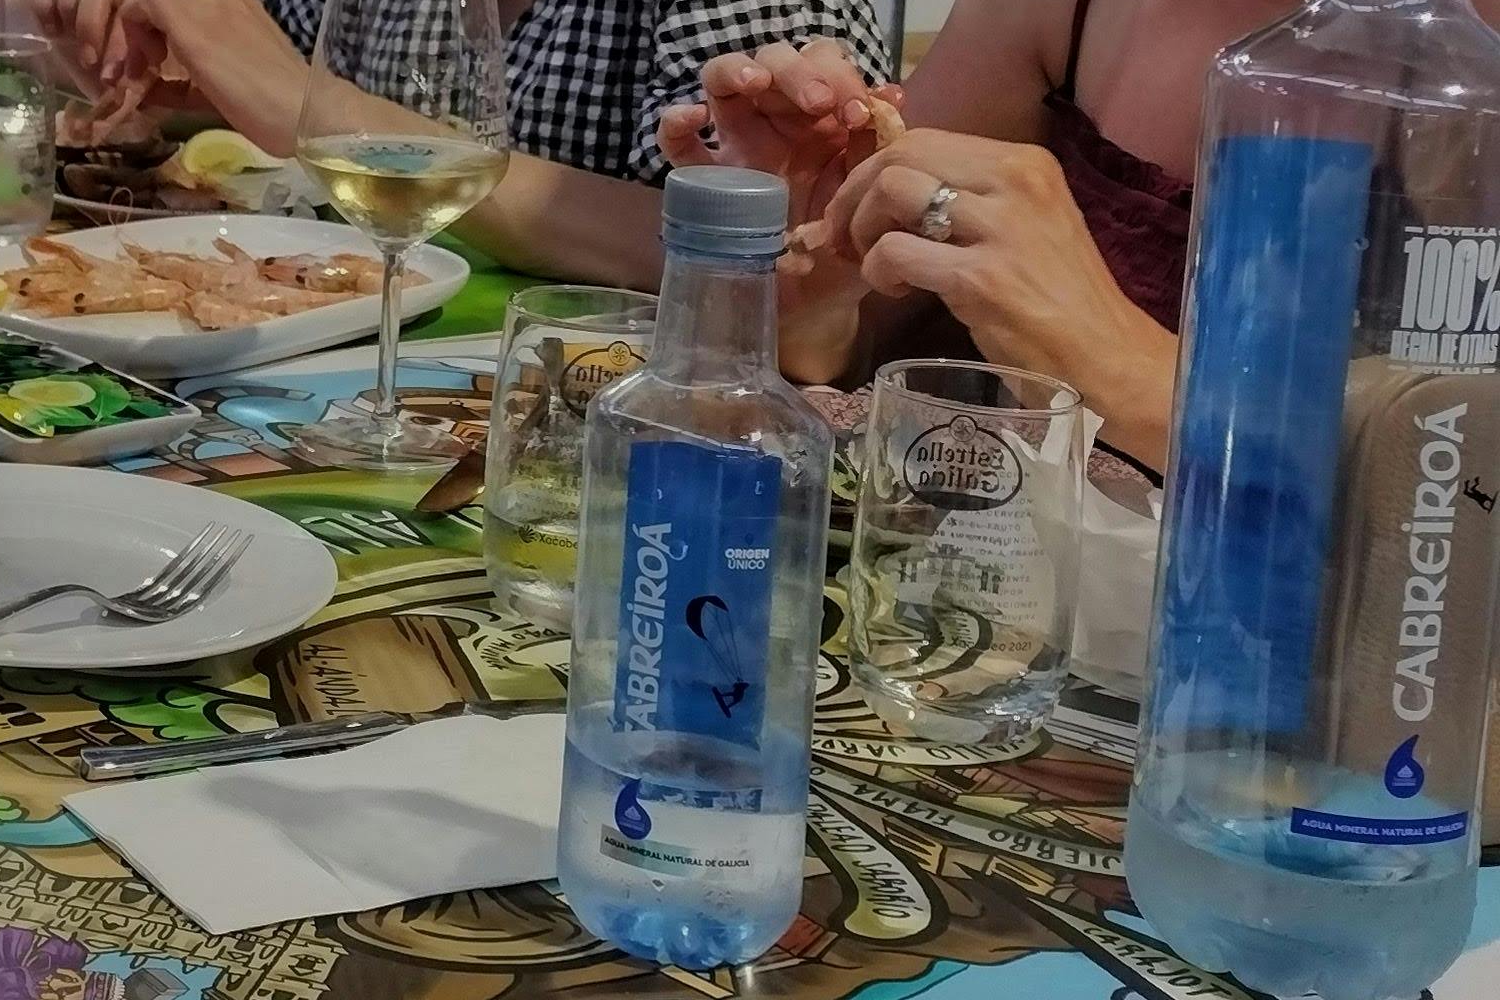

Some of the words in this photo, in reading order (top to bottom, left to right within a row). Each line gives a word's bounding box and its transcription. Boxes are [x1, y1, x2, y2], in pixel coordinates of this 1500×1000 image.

[1400, 236, 1500, 332] 100%
[724, 548, 770, 560] ORIGEN
[727, 558, 766, 570] ÚNICO
[1010, 641, 1032, 651] 2021
[850, 783, 956, 828] FLAMA
[1301, 818, 1333, 832] AGUA
[1334, 823, 1380, 836] MINERAL
[1381, 826, 1424, 837] NATURAL
[1425, 825, 1437, 836] DE
[604, 835, 626, 850] AGUA
[625, 845, 663, 861] MINERAL
[663, 854, 703, 867] NATURAL
[704, 859, 717, 867] DE
[717, 859, 751, 868] GALICIA
